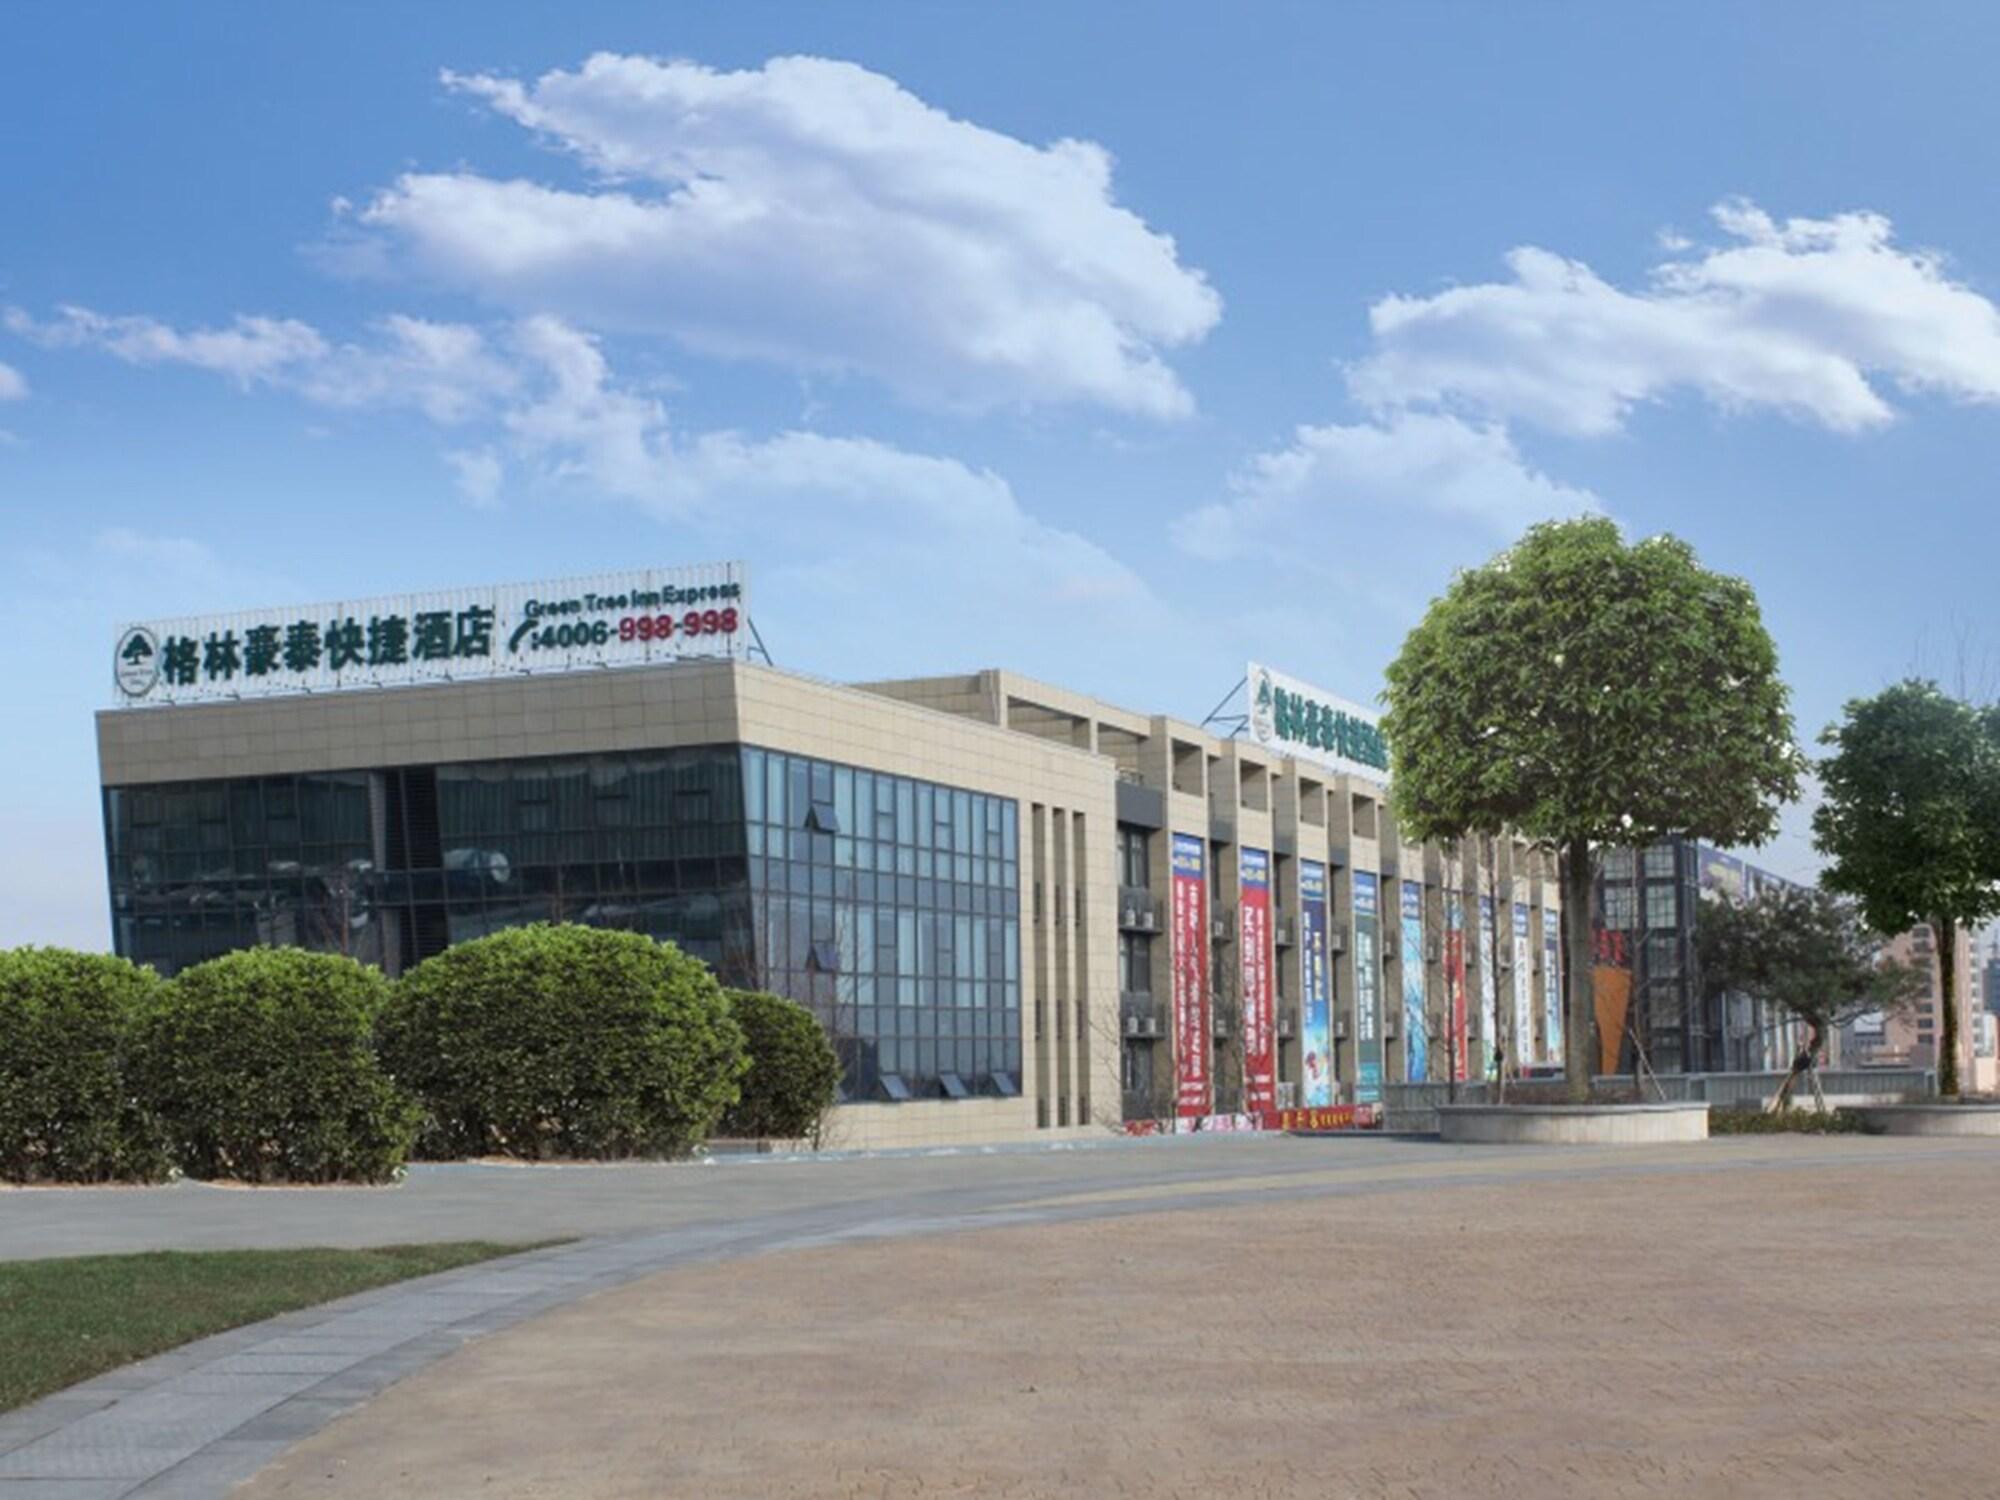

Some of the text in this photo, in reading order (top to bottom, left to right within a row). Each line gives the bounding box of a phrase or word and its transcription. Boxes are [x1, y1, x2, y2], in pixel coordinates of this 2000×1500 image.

[525, 583, 739, 617] Green Tree Inn Express
[162, 604, 494, 686] 格林豪泰快捷酒店
